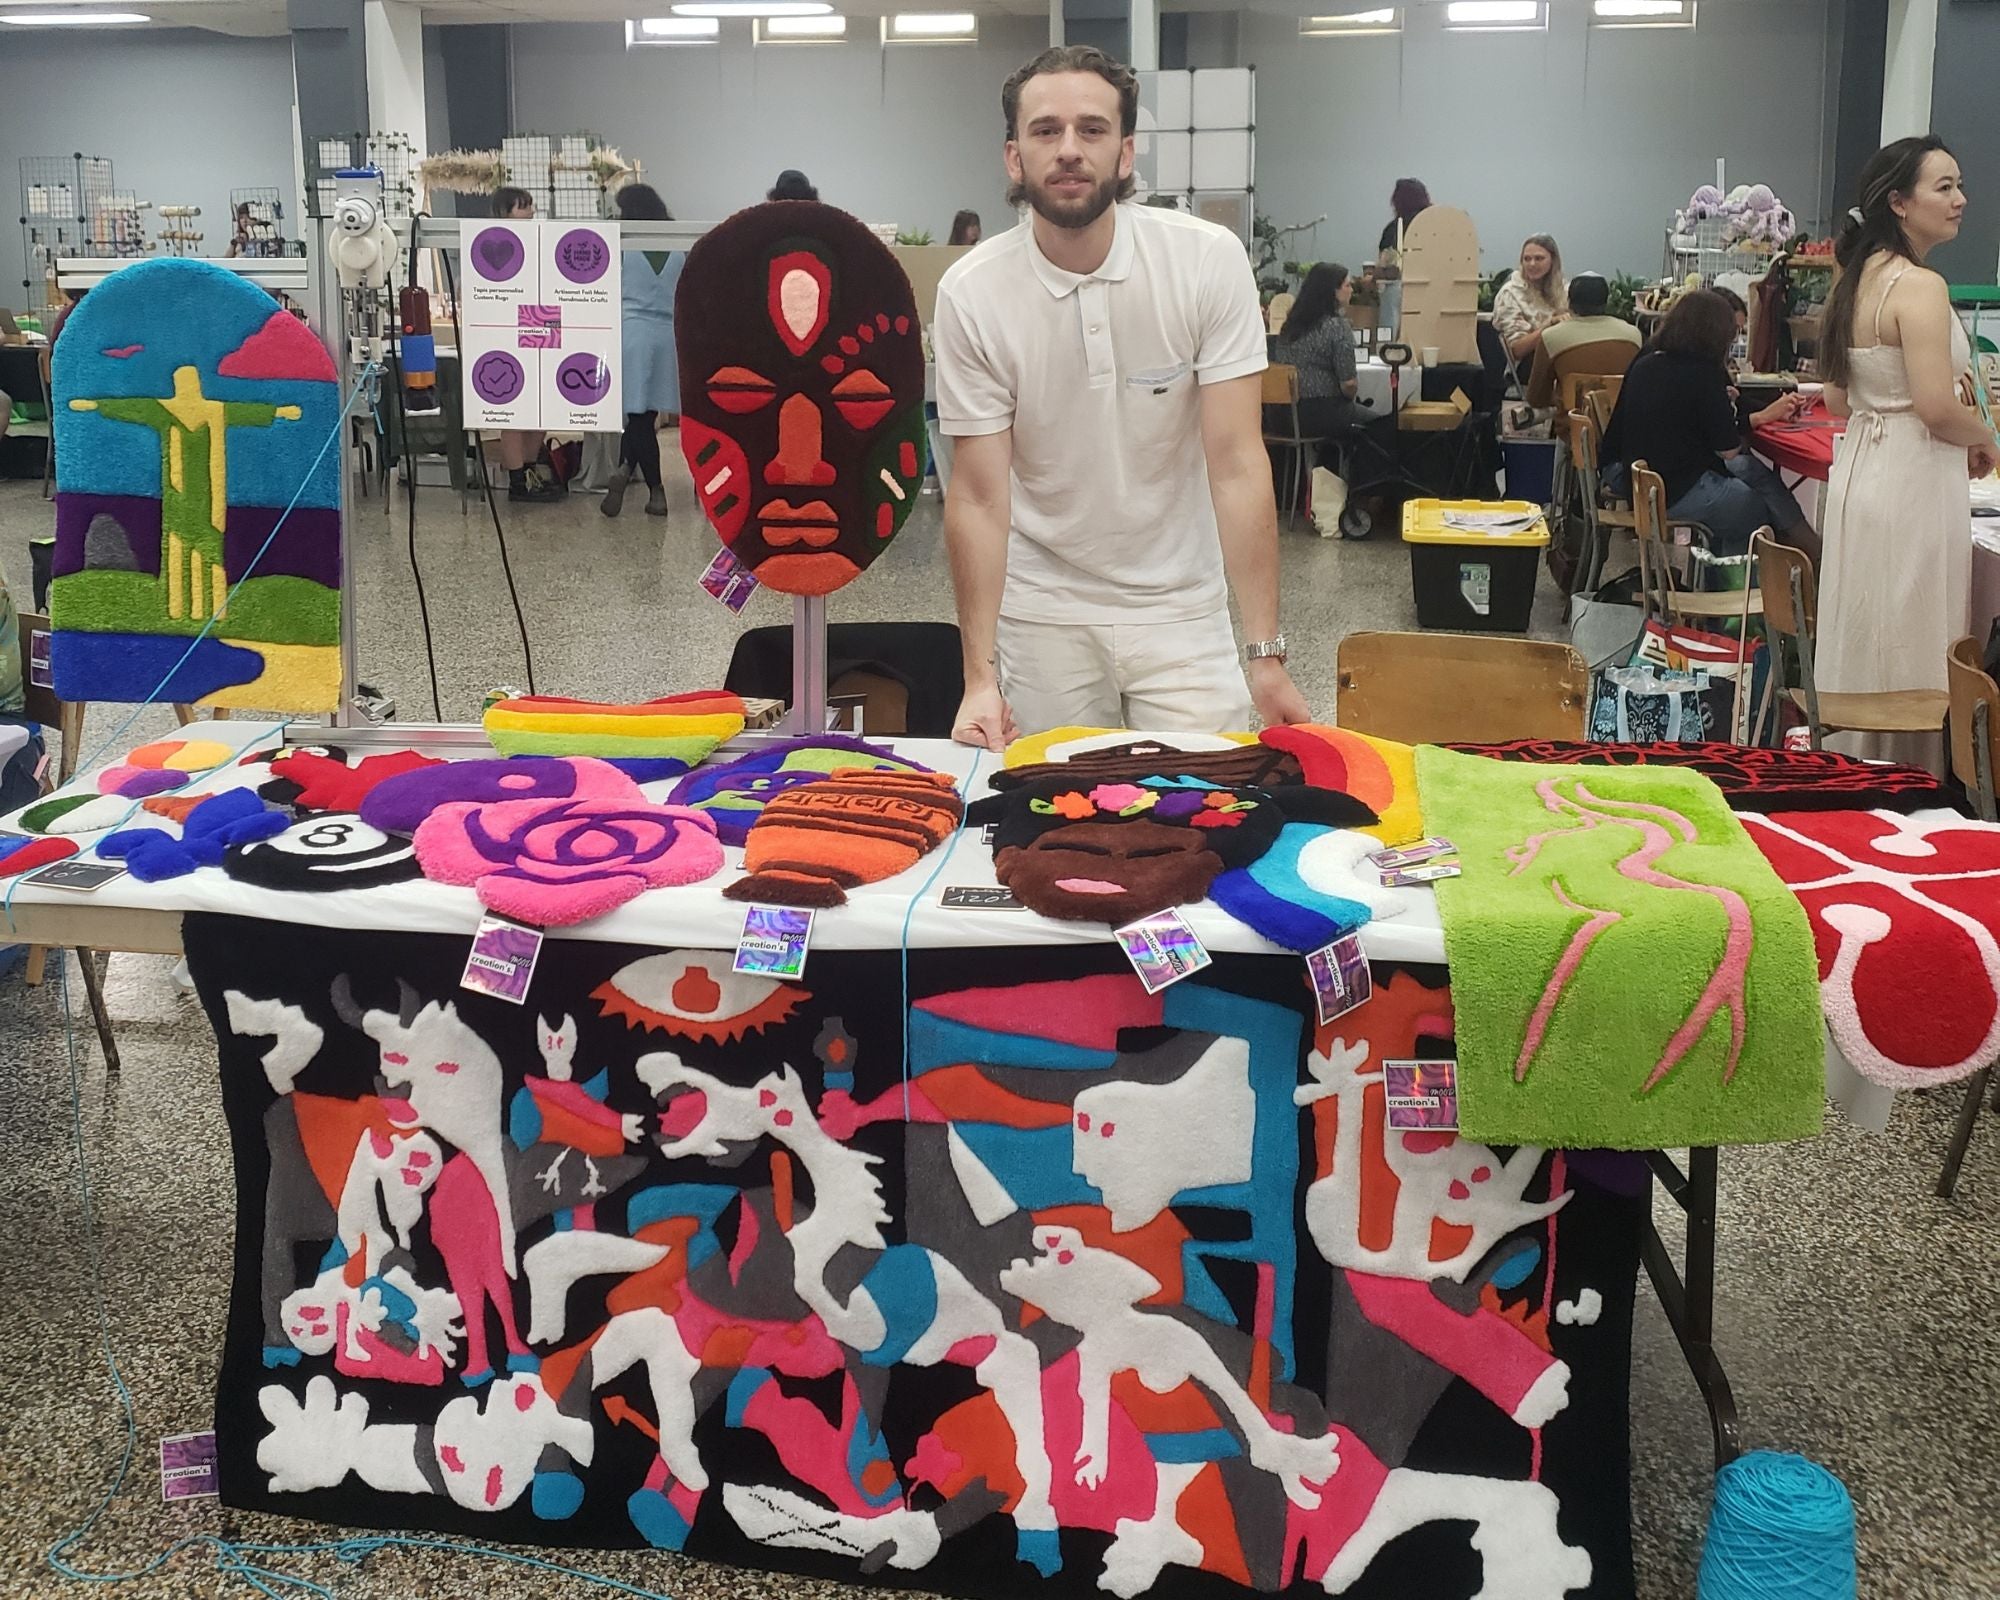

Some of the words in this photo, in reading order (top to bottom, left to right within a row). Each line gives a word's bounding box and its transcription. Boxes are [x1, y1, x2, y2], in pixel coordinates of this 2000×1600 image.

[569, 418, 598, 426] Durability
[299, 824, 353, 848] 8
[741, 940, 786, 951] creation's.
[1140, 927, 1165, 964] eation's.
[471, 956, 513, 974] creation's.
[1326, 949, 1343, 997] creation's.
[1389, 1098, 1438, 1106] creation's.
[164, 1467, 209, 1478] creation's.
